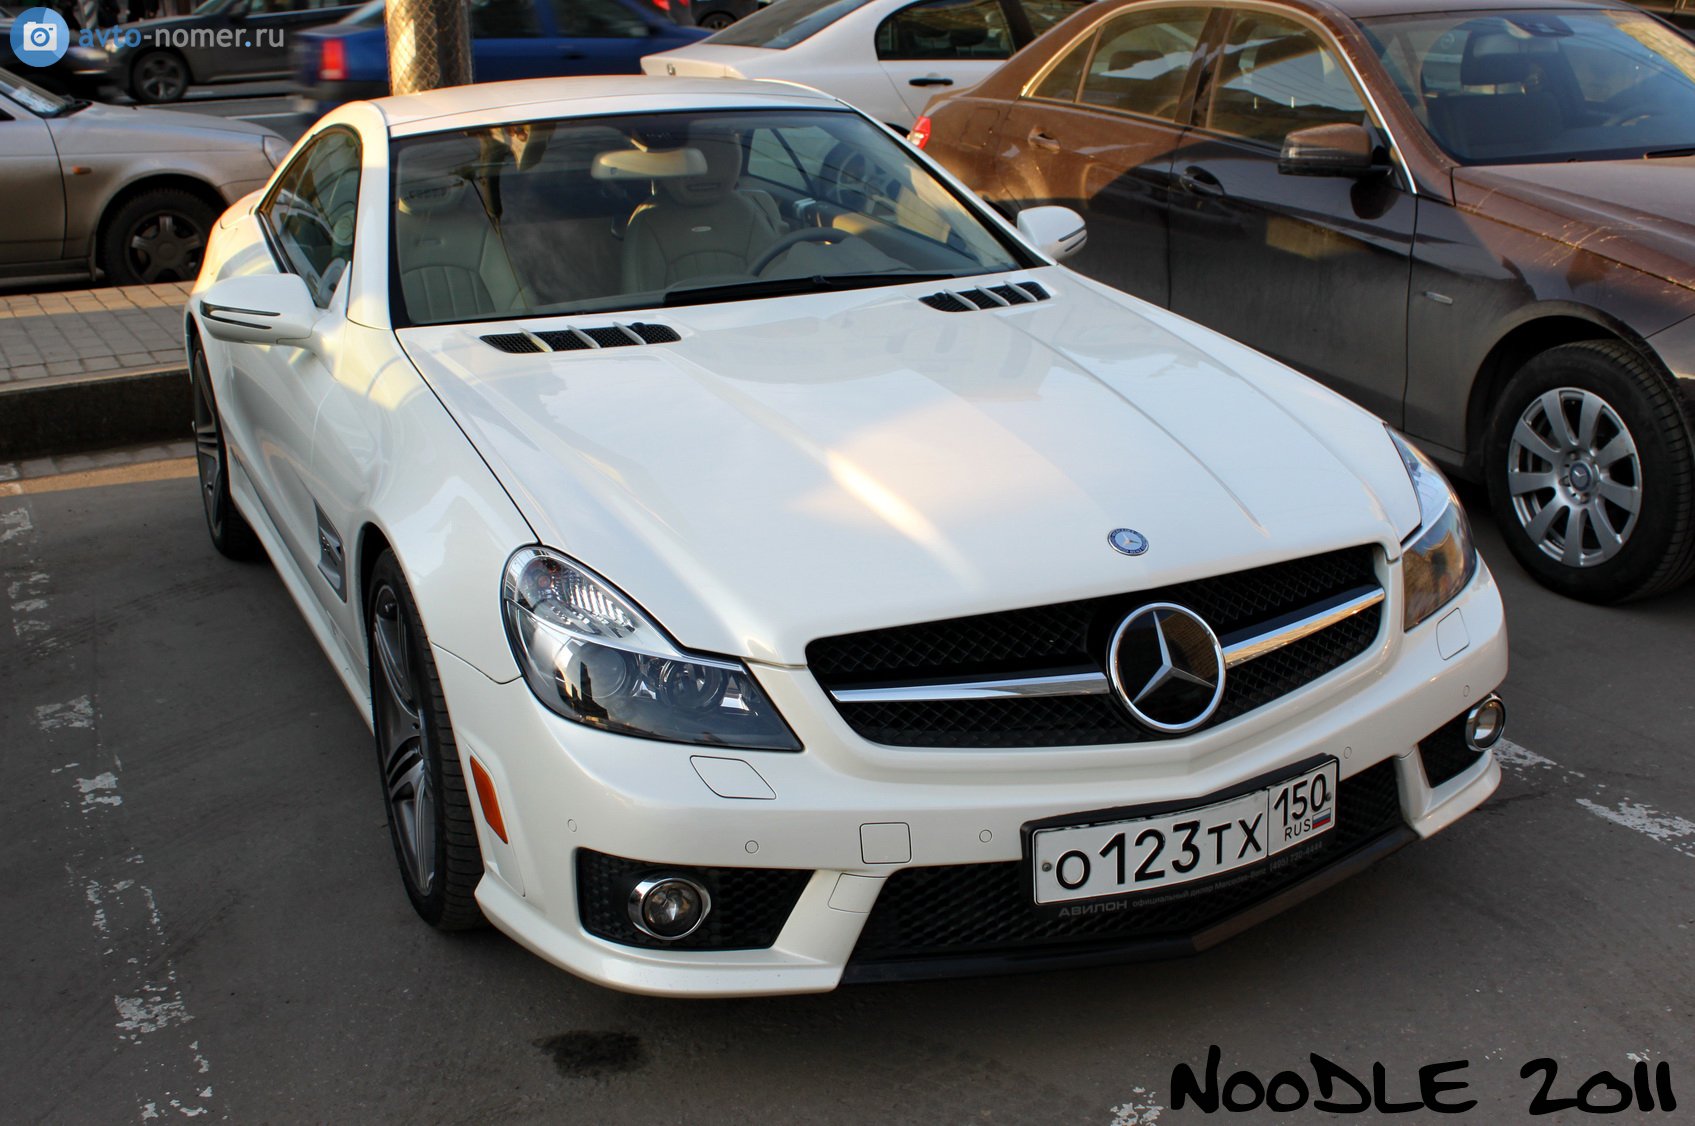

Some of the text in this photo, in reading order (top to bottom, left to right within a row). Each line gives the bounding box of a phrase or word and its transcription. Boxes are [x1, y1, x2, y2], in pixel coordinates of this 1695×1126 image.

[1273, 773, 1326, 828] 150
[1284, 818, 1311, 842] RUS
[1058, 900, 1128, 918] АВИЛОН
